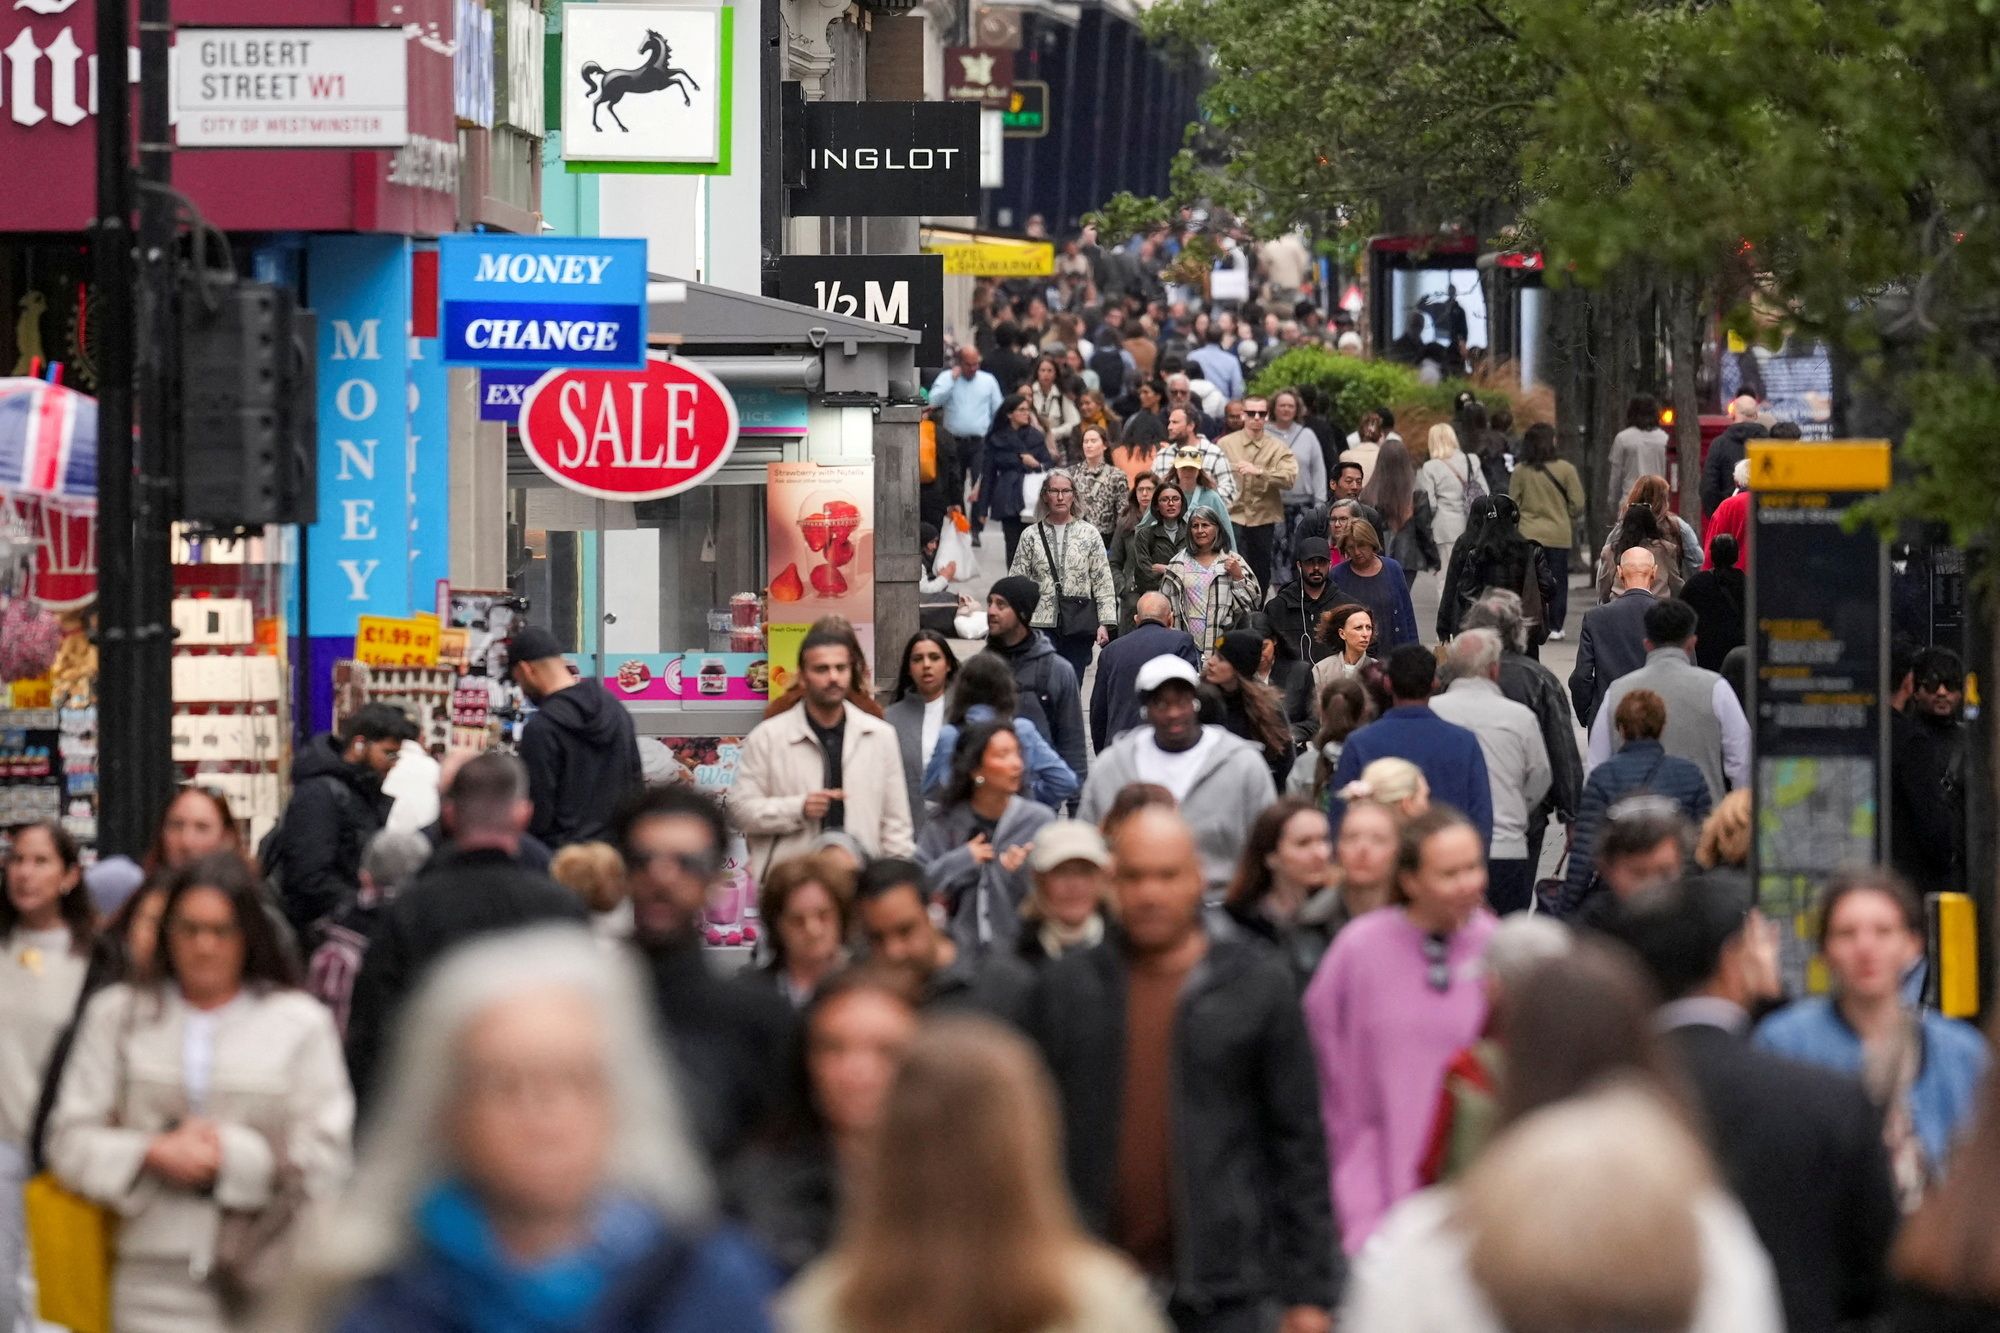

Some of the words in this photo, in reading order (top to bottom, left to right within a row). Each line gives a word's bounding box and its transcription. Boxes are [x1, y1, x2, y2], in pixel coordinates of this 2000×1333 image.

[201, 40, 311, 67] GILBERT
[201, 73, 298, 100] STREET
[307, 74, 346, 98] W1
[202, 117, 235, 134] CITY
[241, 117, 258, 134] OF
[266, 117, 381, 134] WESTMINSTER
[811, 148, 960, 170] INGLOT
[474, 253, 613, 285] MONEY
[464, 318, 620, 352] CHANGE
[557, 379, 700, 470] SALE
[330, 318, 382, 600] MONEY
[774, 468, 816, 478] Strawberry
[818, 468, 836, 477] with
